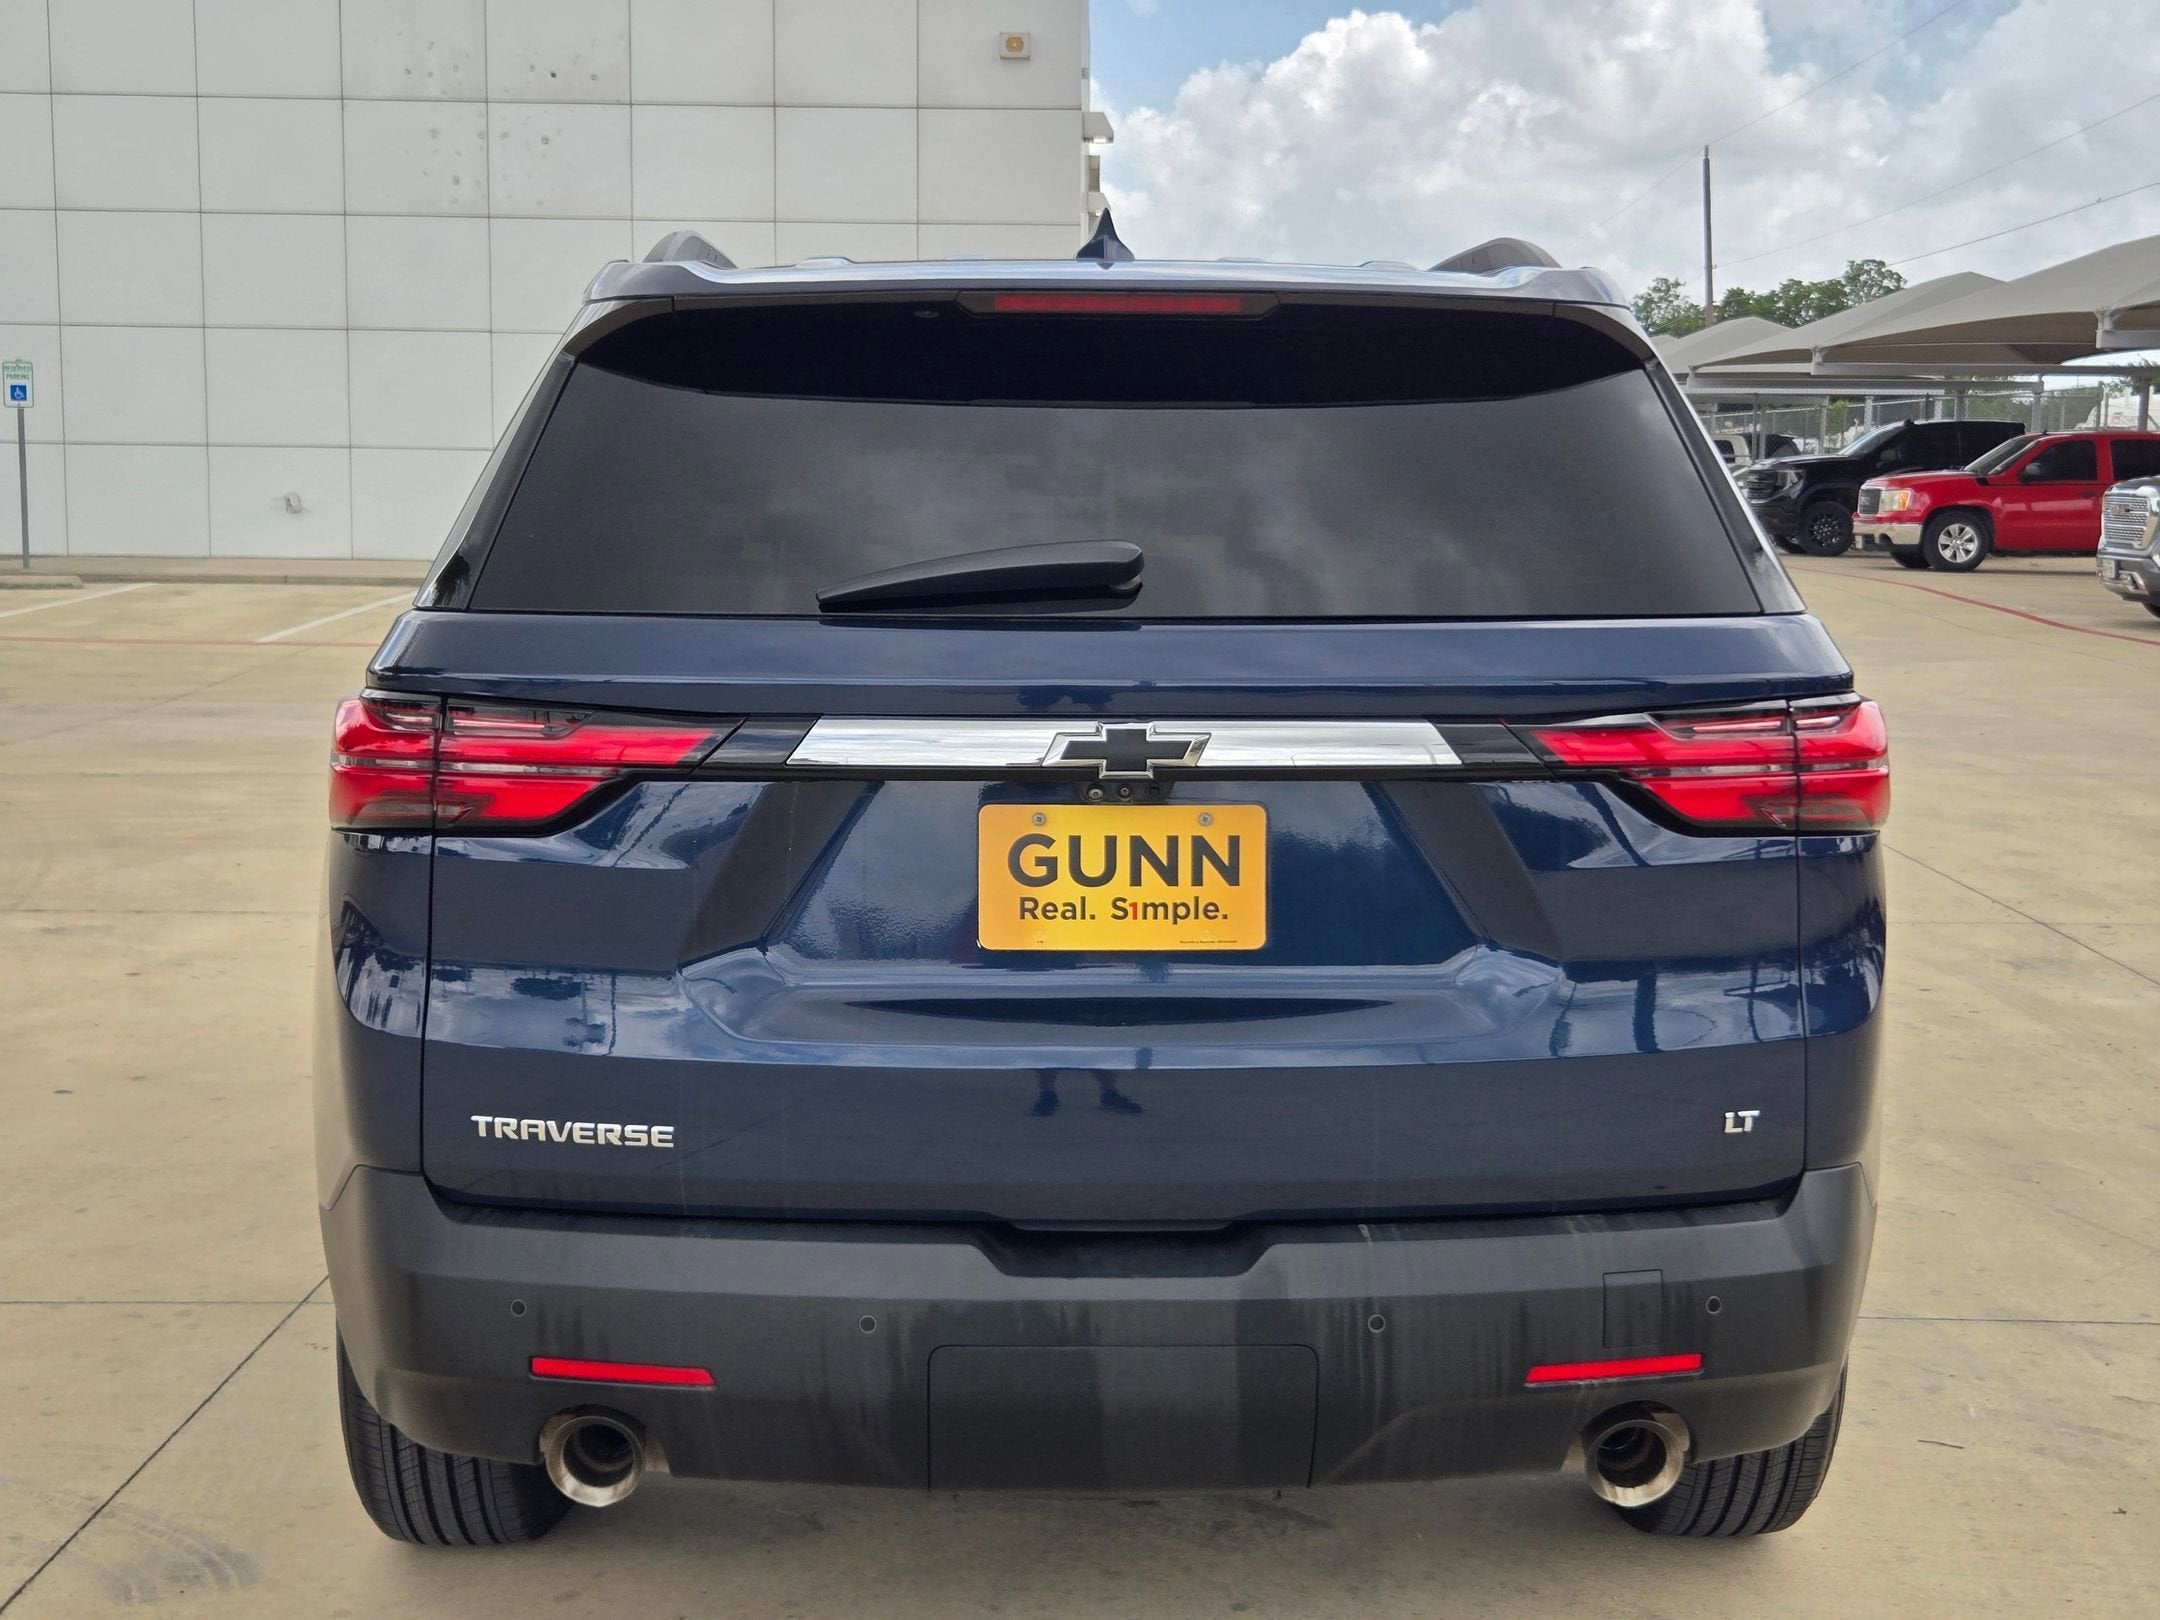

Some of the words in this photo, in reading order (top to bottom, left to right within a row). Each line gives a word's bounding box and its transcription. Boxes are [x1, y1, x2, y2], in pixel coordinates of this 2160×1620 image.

[1007, 833, 1240, 887] GUNN
[1019, 896, 1095, 920] Real.
[470, 1115, 674, 1148] TRAVERSE
[1724, 1110, 1760, 1133] LT
